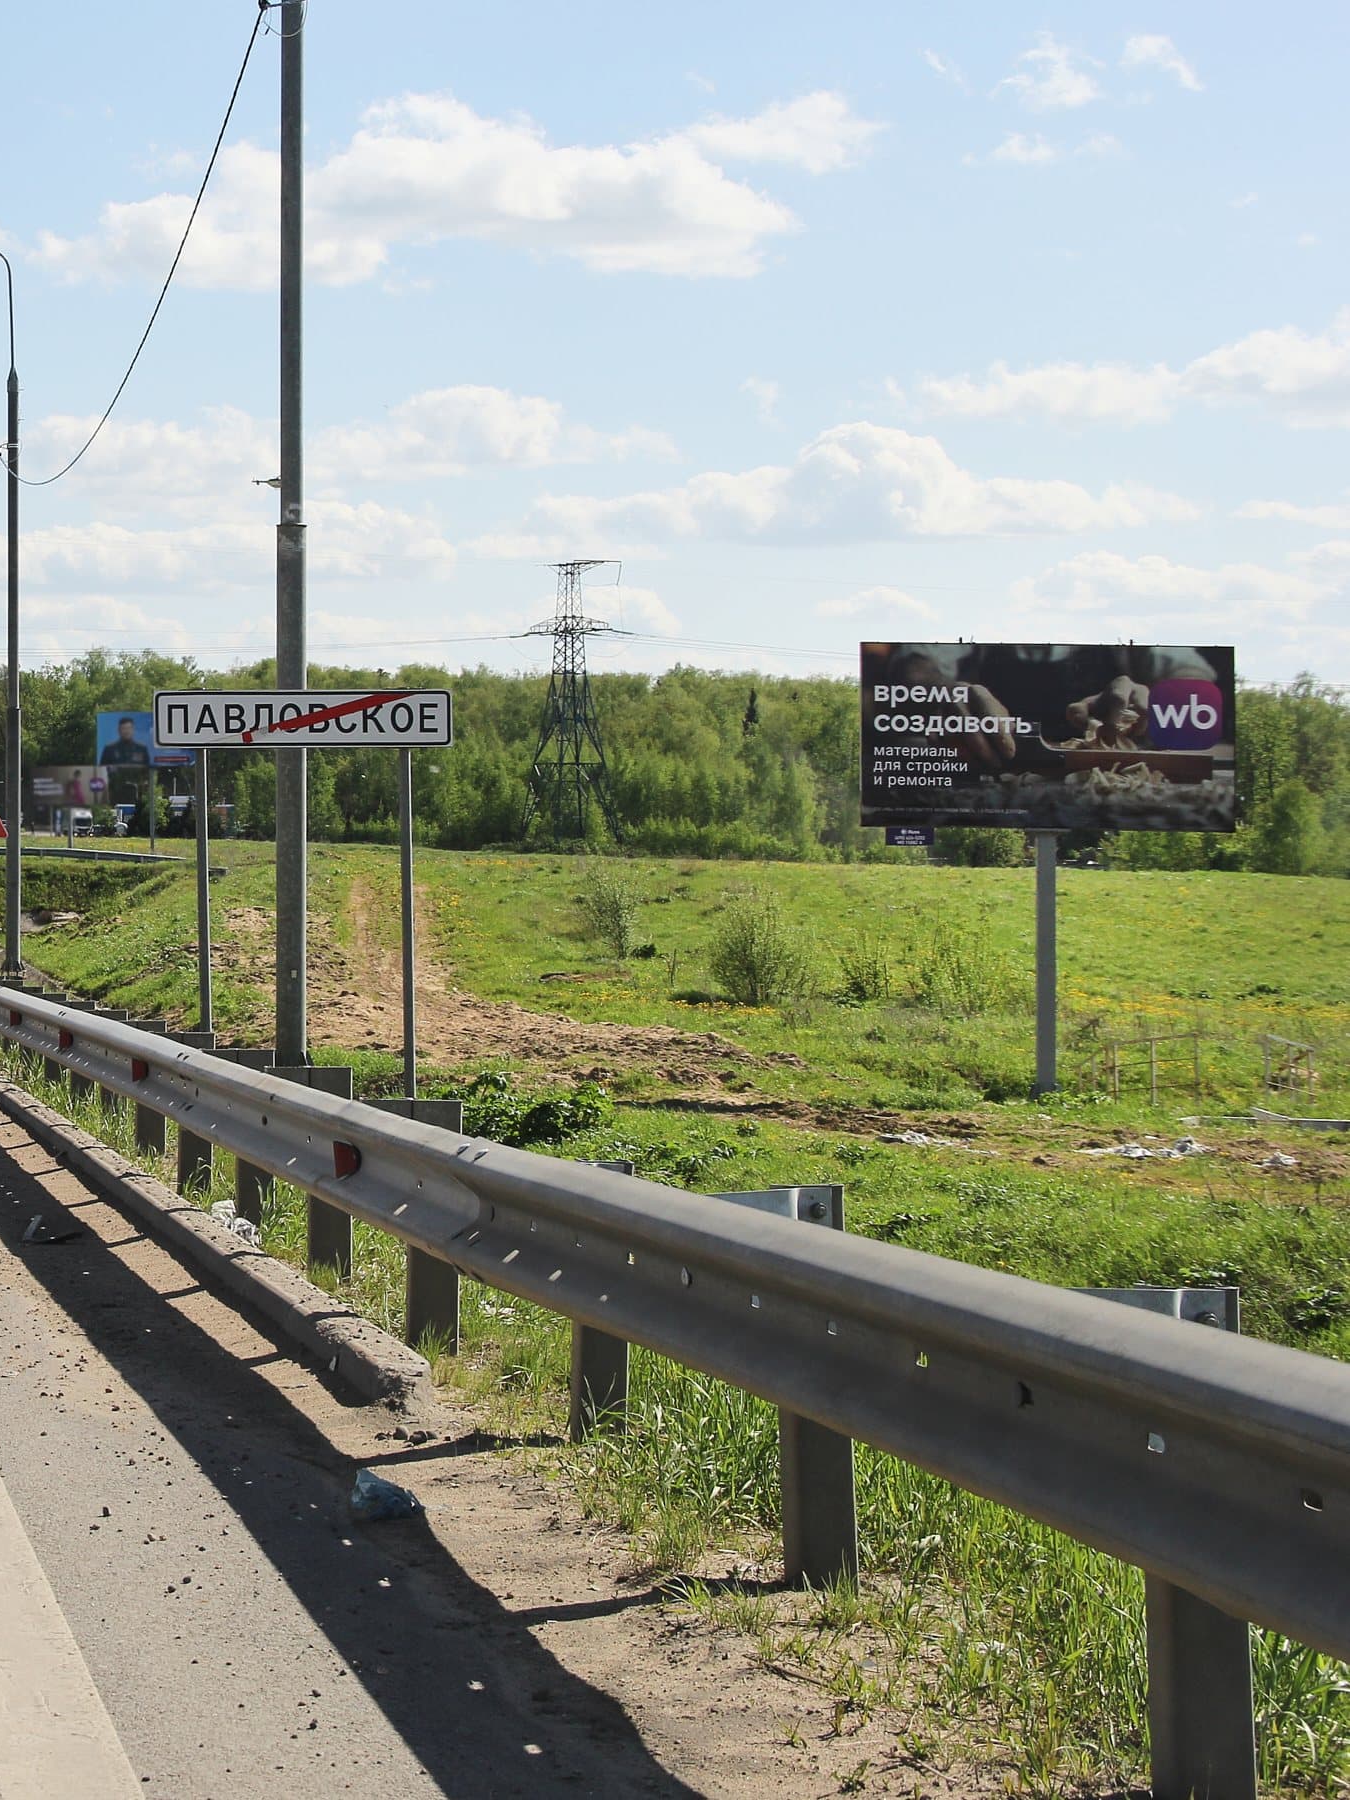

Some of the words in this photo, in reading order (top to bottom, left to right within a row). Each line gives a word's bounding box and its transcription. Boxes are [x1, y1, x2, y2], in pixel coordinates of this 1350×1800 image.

[873, 685, 969, 708] время
[166, 703, 439, 734] ПАВЛОВСКОЕ
[1152, 693, 1218, 730] wb
[873, 714, 1032, 736] создавать
[873, 746, 958, 759] материалы
[873, 761, 901, 772] для
[906, 760, 969, 774] стройки
[873, 776, 882, 785] и
[888, 776, 953, 788] ремонта
